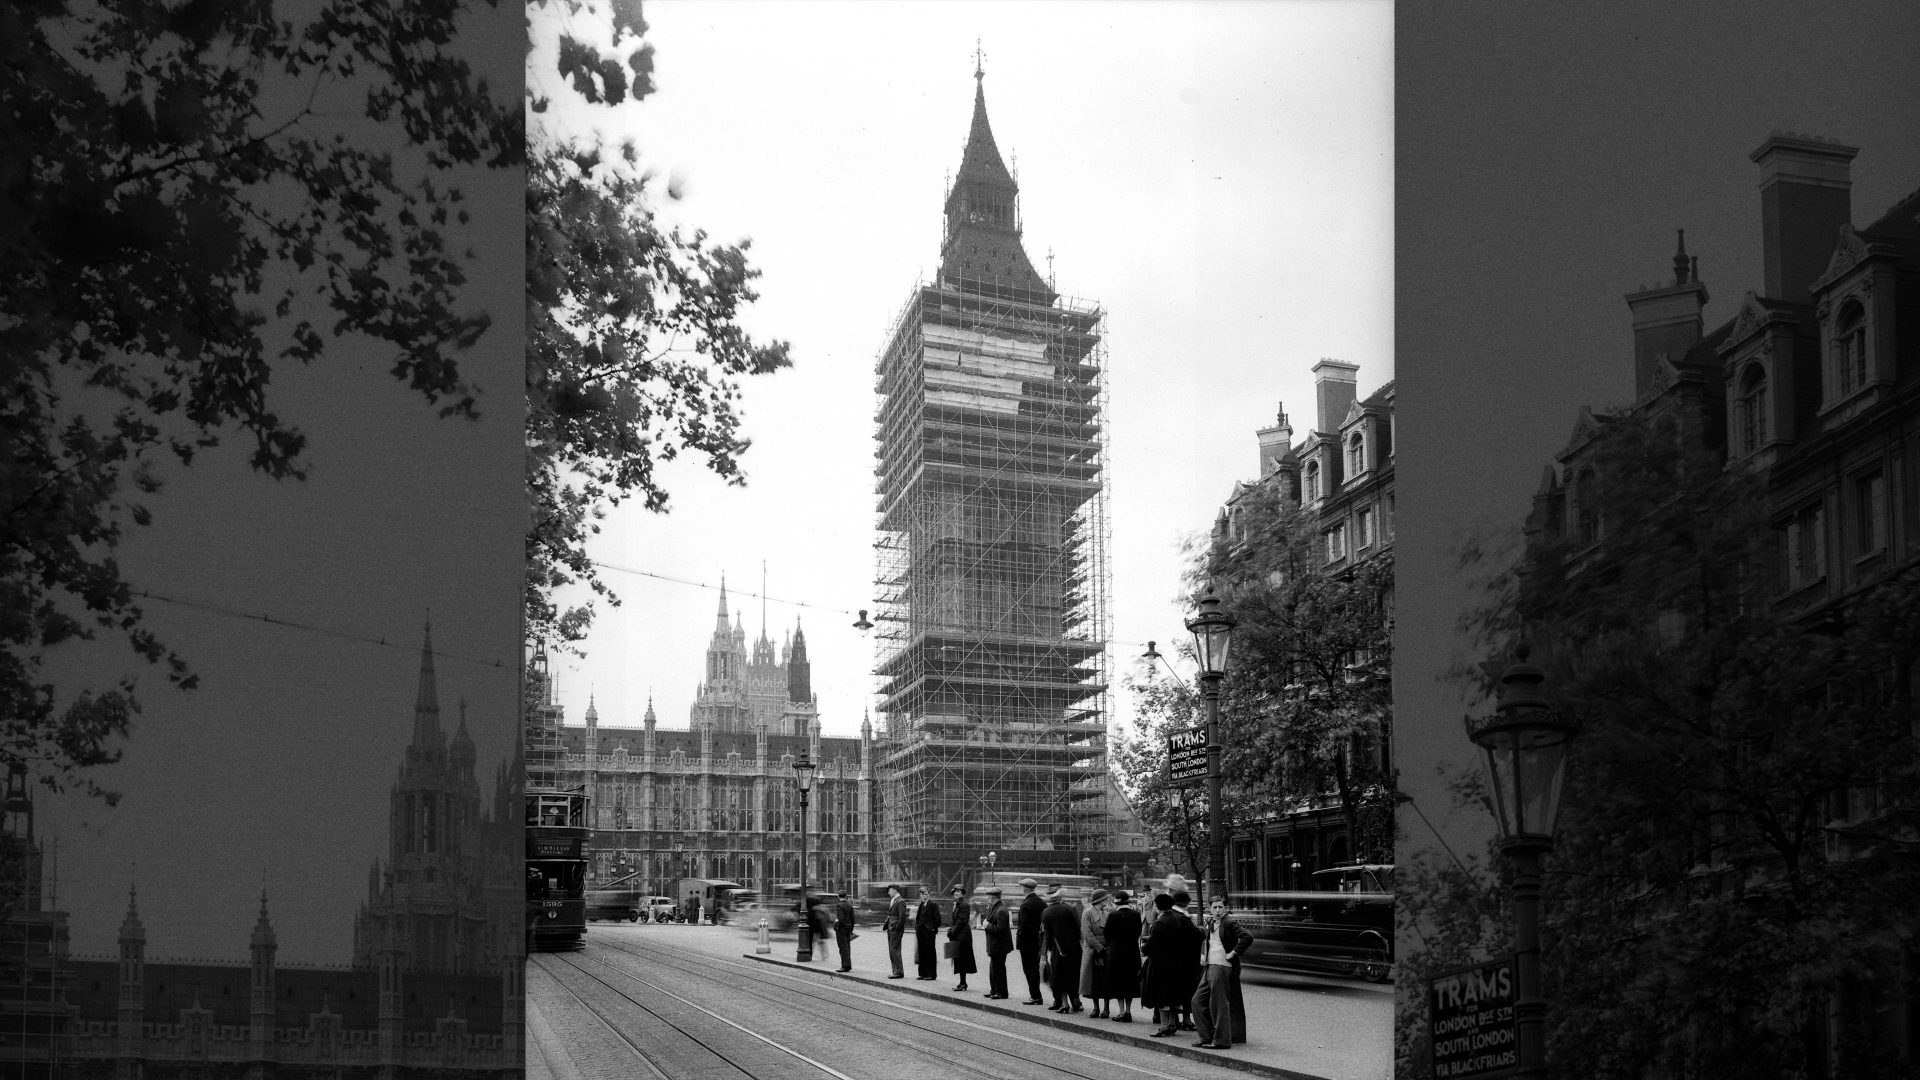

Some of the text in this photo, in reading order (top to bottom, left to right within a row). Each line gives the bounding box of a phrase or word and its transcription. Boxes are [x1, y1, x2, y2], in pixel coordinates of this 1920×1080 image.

[1170, 730, 1206, 749] TRAMS
[1170, 751, 1190, 760] LONDON
[1171, 761, 1187, 770] SOUTH
[1188, 757, 1207, 767] LONDON
[1179, 767, 1208, 778] BLACKFRIARS
[1433, 967, 1511, 1010] TRAMS
[1434, 1014, 1476, 1035] LONDON
[1434, 1027, 1515, 1057] SOUTH LONDON
[1435, 1050, 1516, 1077] VIA BLACKFRIARS
